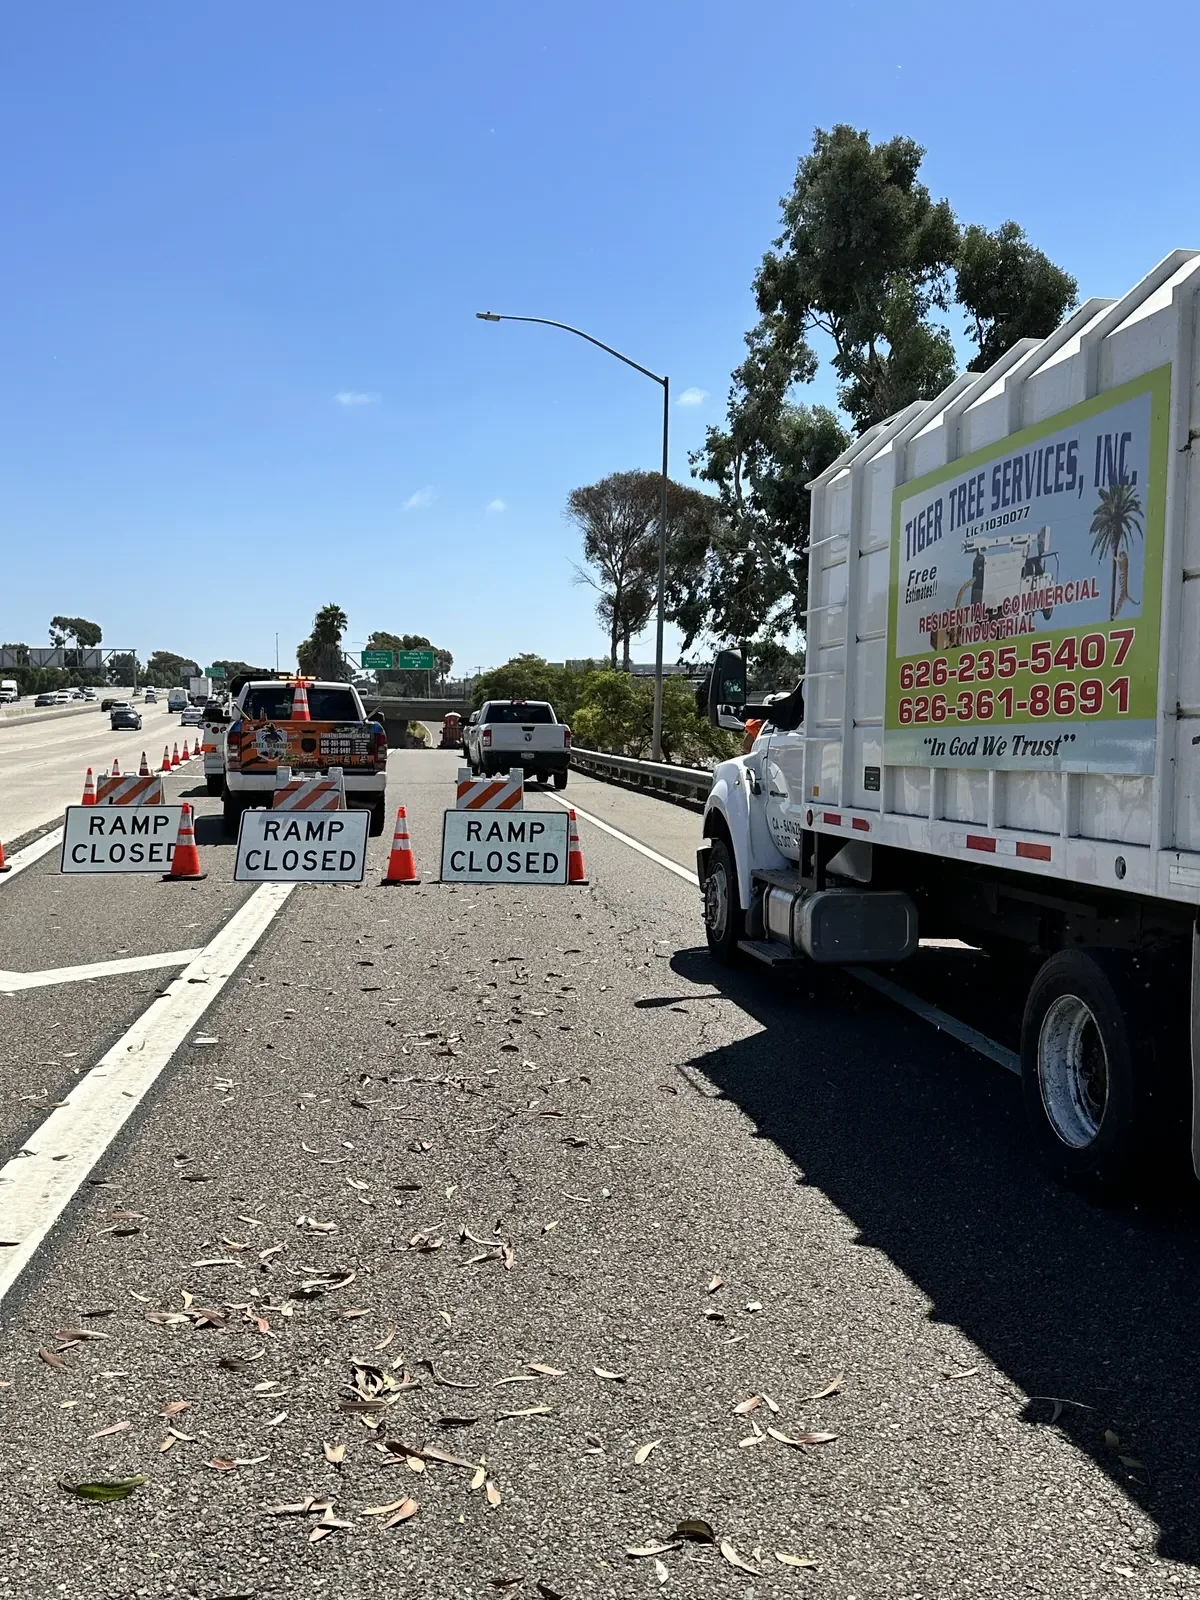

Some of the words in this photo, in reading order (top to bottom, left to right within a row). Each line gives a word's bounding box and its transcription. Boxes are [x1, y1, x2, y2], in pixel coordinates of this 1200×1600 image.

[905, 498, 943, 562] TIGER
[949, 471, 985, 531] TREE
[991, 440, 1084, 512] SERVICES,
[1094, 432, 1137, 487] INC.
[908, 566, 937, 586] Free
[905, 580, 938, 604] Estimates!!
[919, 602, 989, 634] RESIDENTIAL
[1002, 578, 1100, 618] COMMERCIAL
[961, 614, 1036, 644] INDUSTRIAL
[899, 627, 1136, 690] 626-235-5407
[898, 676, 1131, 725] 626-361-8691
[949, 736, 979, 757] God
[981, 735, 1006, 757] We
[89, 815, 169, 836] RAMP
[263, 820, 345, 842] RAMP
[466, 821, 546, 843] RAMP
[245, 850, 356, 871] CLOSED
[450, 851, 559, 873] CLOSED
